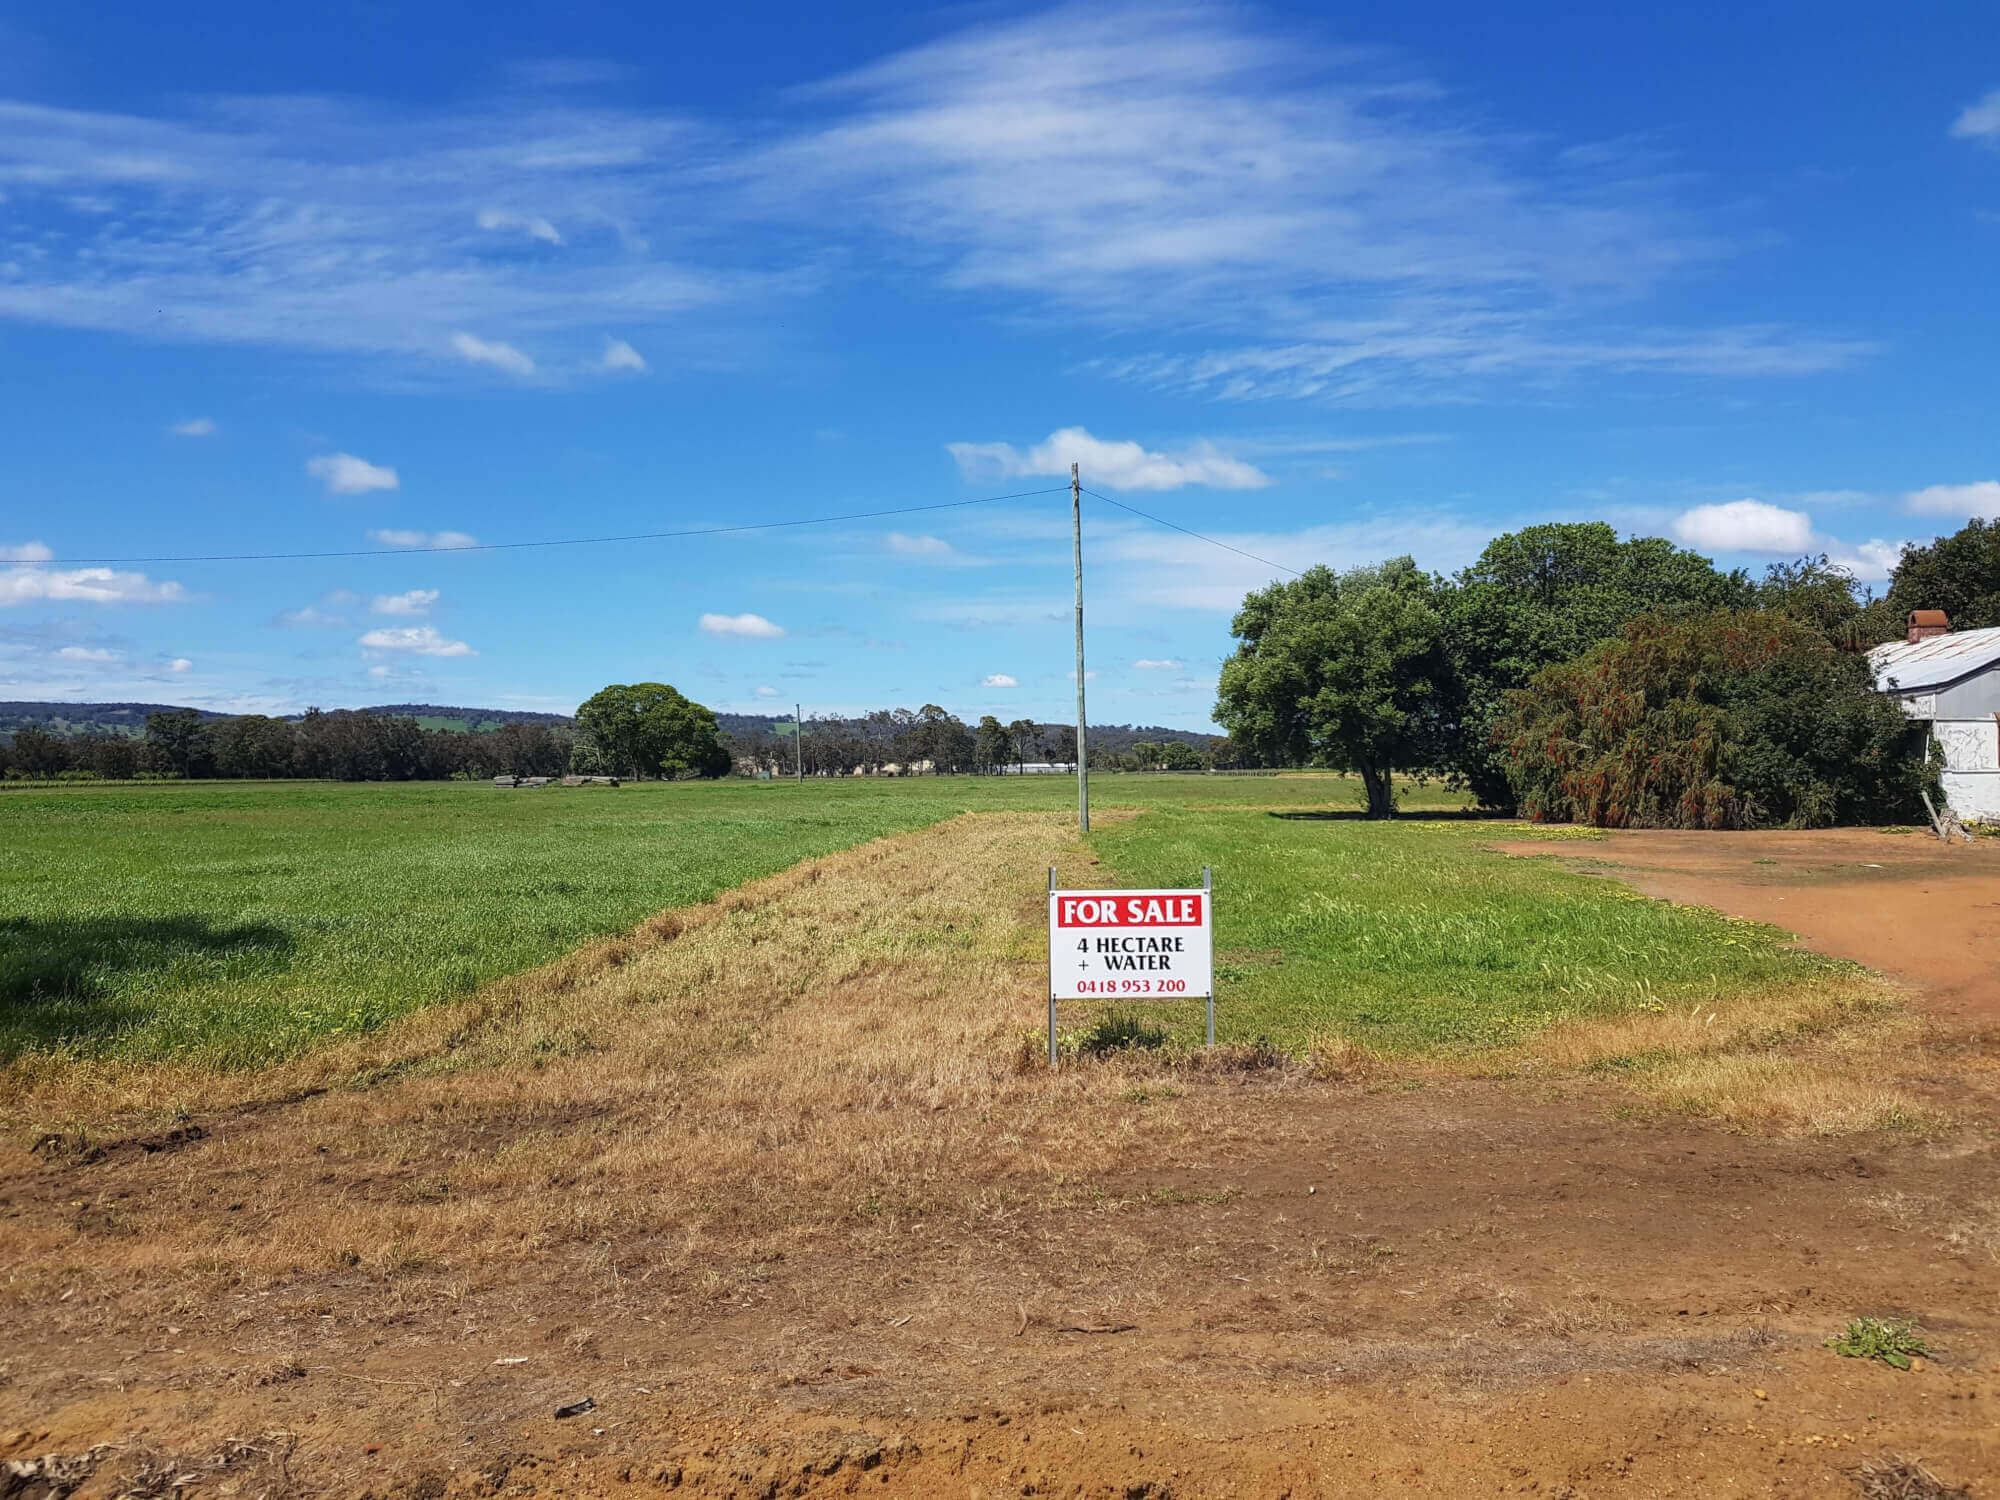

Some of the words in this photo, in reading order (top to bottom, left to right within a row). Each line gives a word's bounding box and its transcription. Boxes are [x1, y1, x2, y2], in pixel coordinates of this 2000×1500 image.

[1063, 899, 1119, 924] FOR
[1127, 899, 1196, 923] SALE
[1077, 938, 1089, 953] 4
[1096, 937, 1185, 953] HECTARE
[1104, 955, 1171, 970] WATER
[1077, 980, 1116, 993] 0418
[1121, 979, 1151, 993] 953
[1156, 979, 1186, 992] 200
